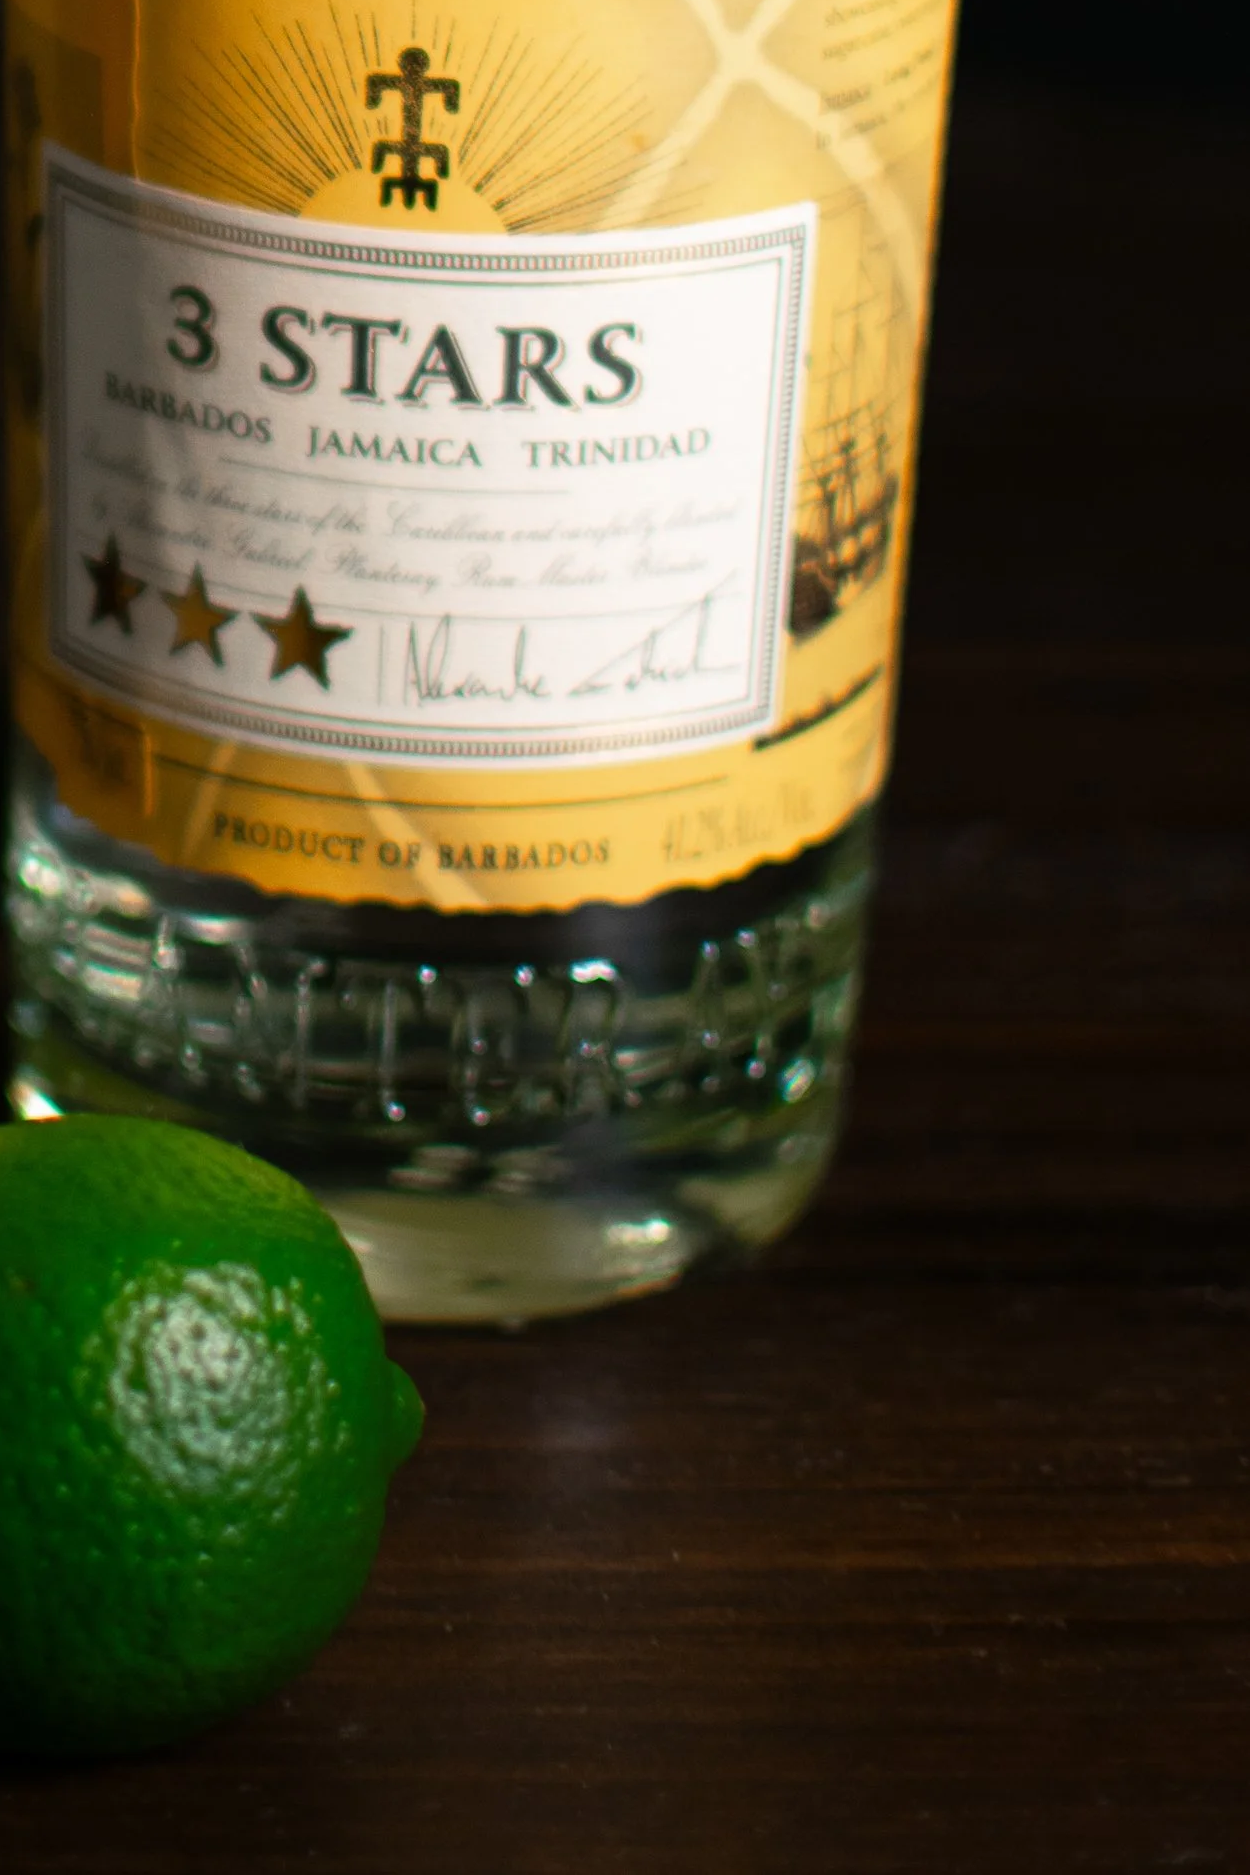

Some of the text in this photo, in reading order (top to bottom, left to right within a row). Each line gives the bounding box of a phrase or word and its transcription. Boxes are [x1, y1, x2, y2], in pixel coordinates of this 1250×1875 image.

[166, 283, 644, 412] 3 STARS
[104, 370, 713, 469] BARBADOS JAMAICA TRINIDAD
[214, 811, 366, 864] PRODUCT
[377, 839, 422, 869] OF
[437, 837, 611, 871] BARBADOS
